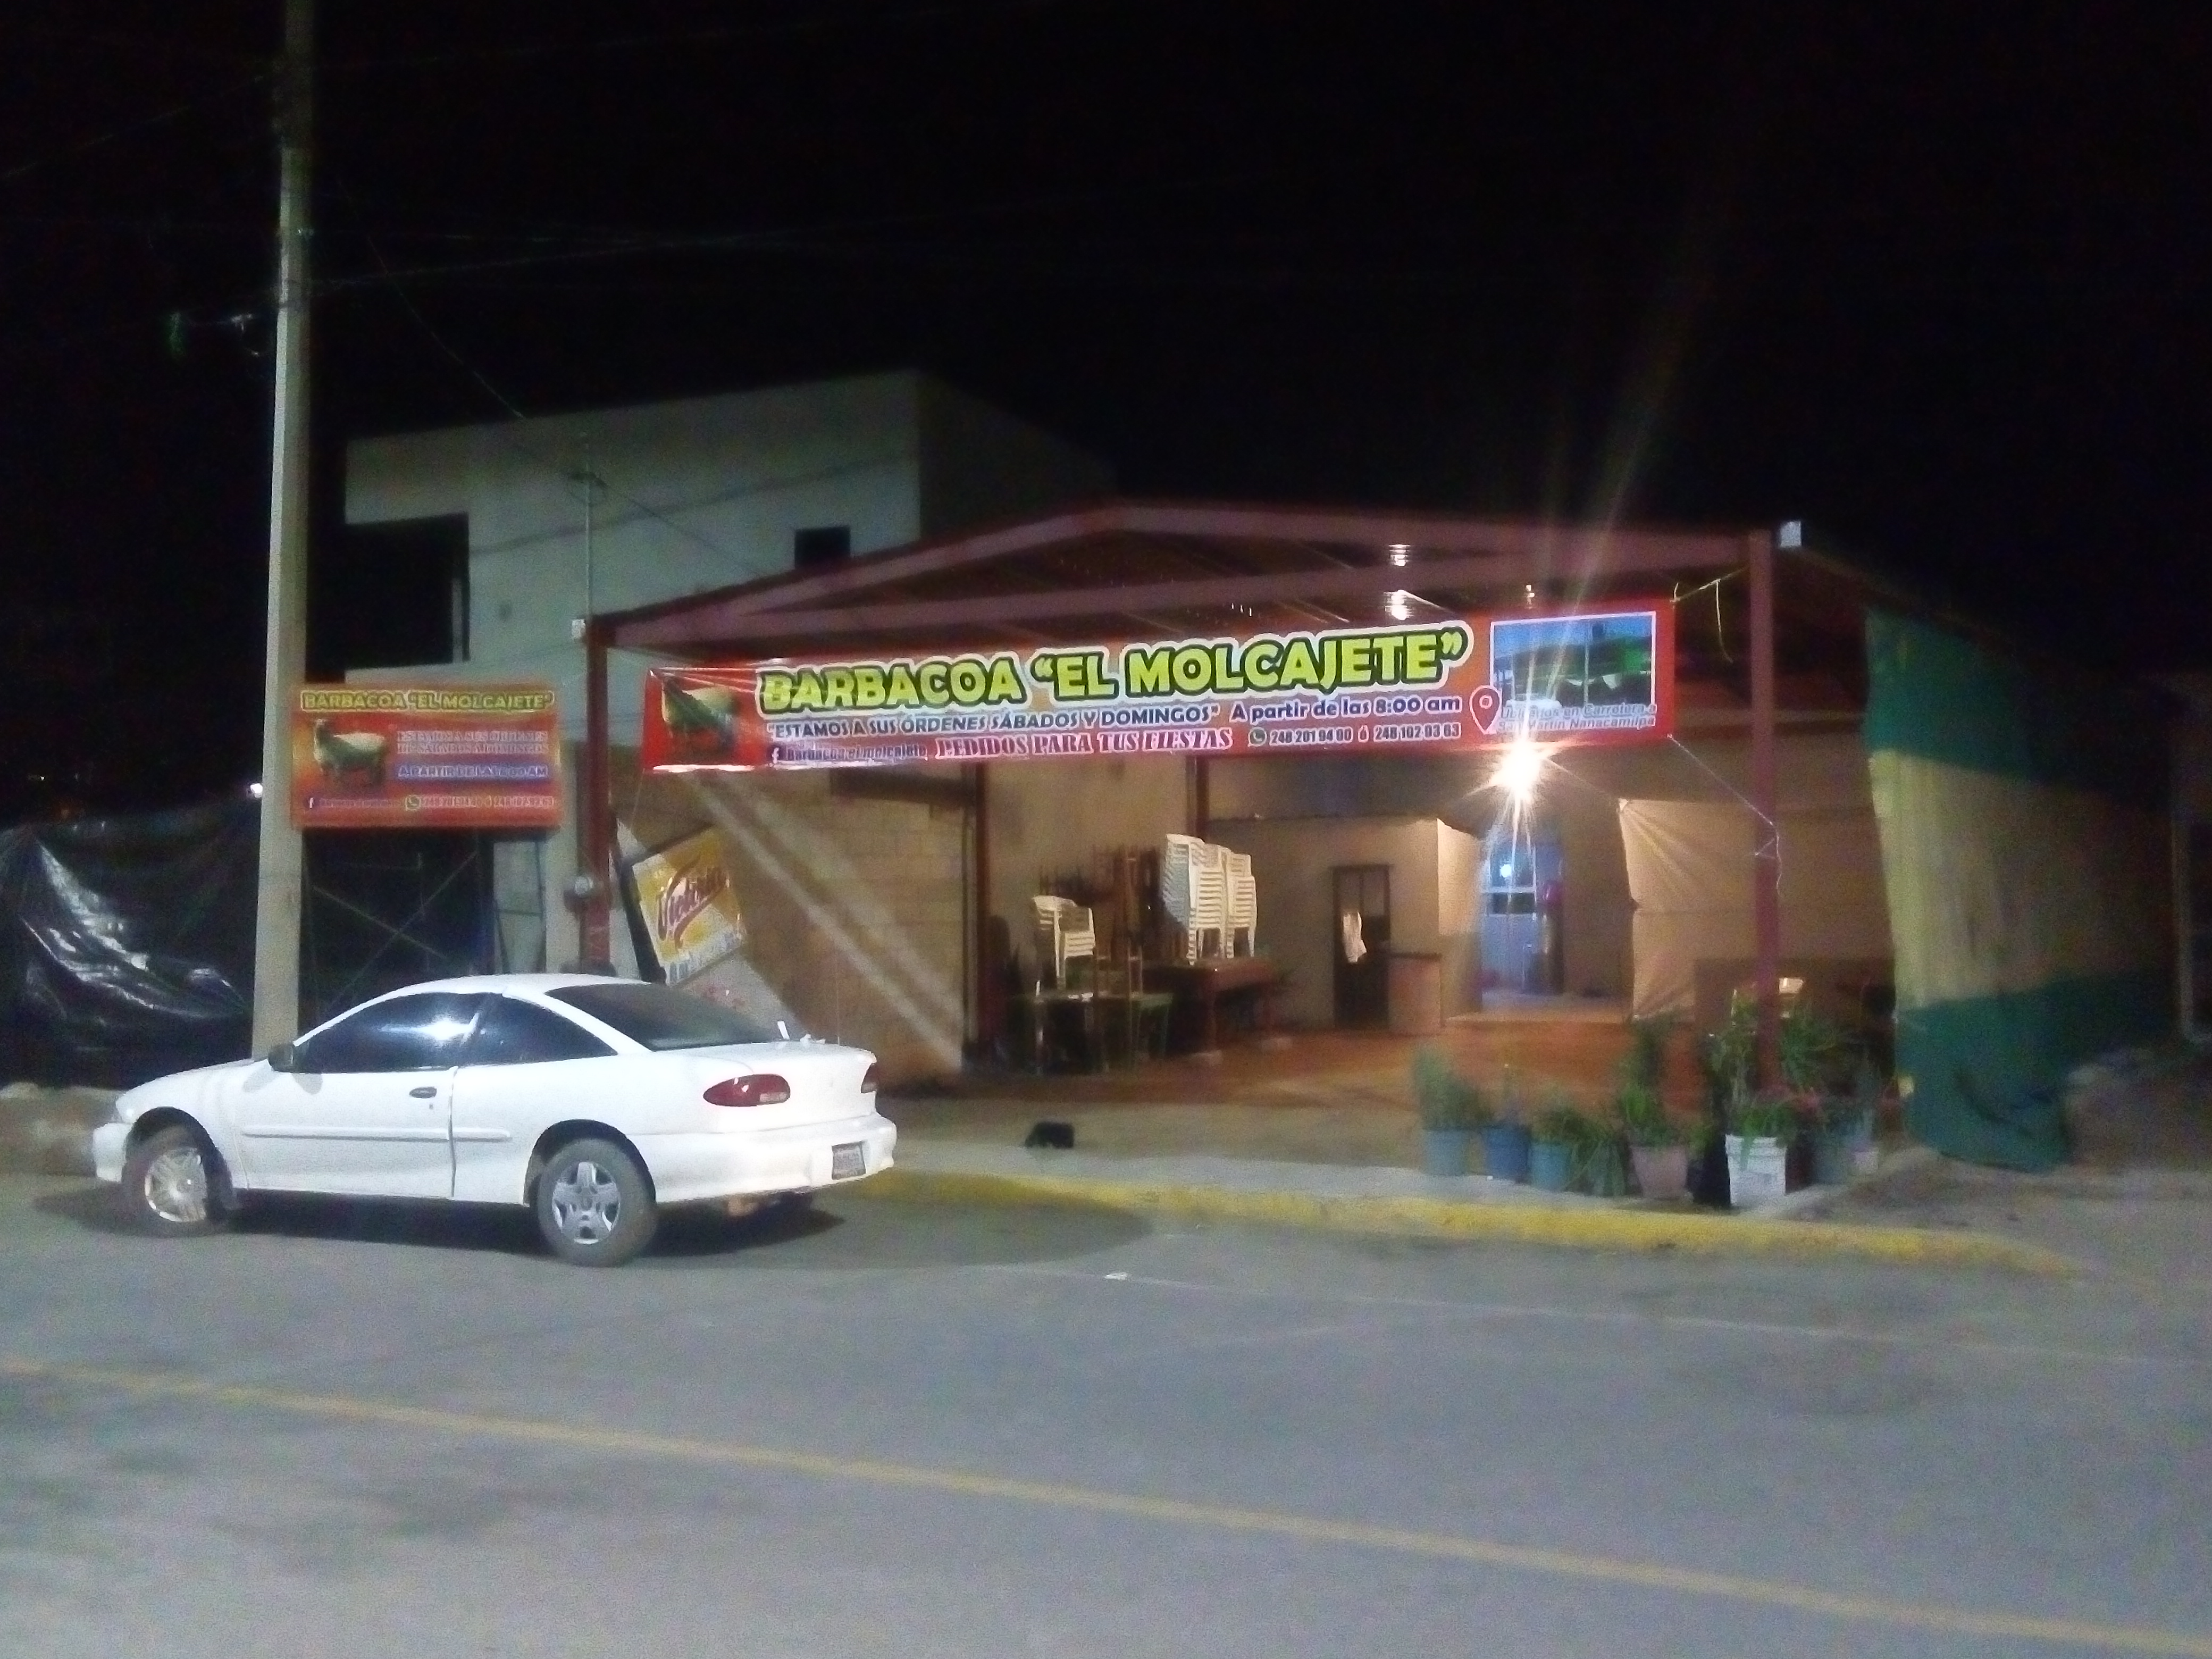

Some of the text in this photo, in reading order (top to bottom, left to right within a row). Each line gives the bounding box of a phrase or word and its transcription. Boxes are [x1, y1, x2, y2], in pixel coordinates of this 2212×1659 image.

[760, 623, 1468, 714] BARBACOA “EL MOLCAJETE”
[304, 693, 406, 709] BARBACOA
[1231, 697, 1460, 724] A partir de las 8:00 am
[853, 720, 866, 734] A
[869, 719, 896, 734] SUS
[1082, 710, 1097, 725] Y
[938, 728, 1233, 756] PEDIDOS PARA TUS FIESTAS
